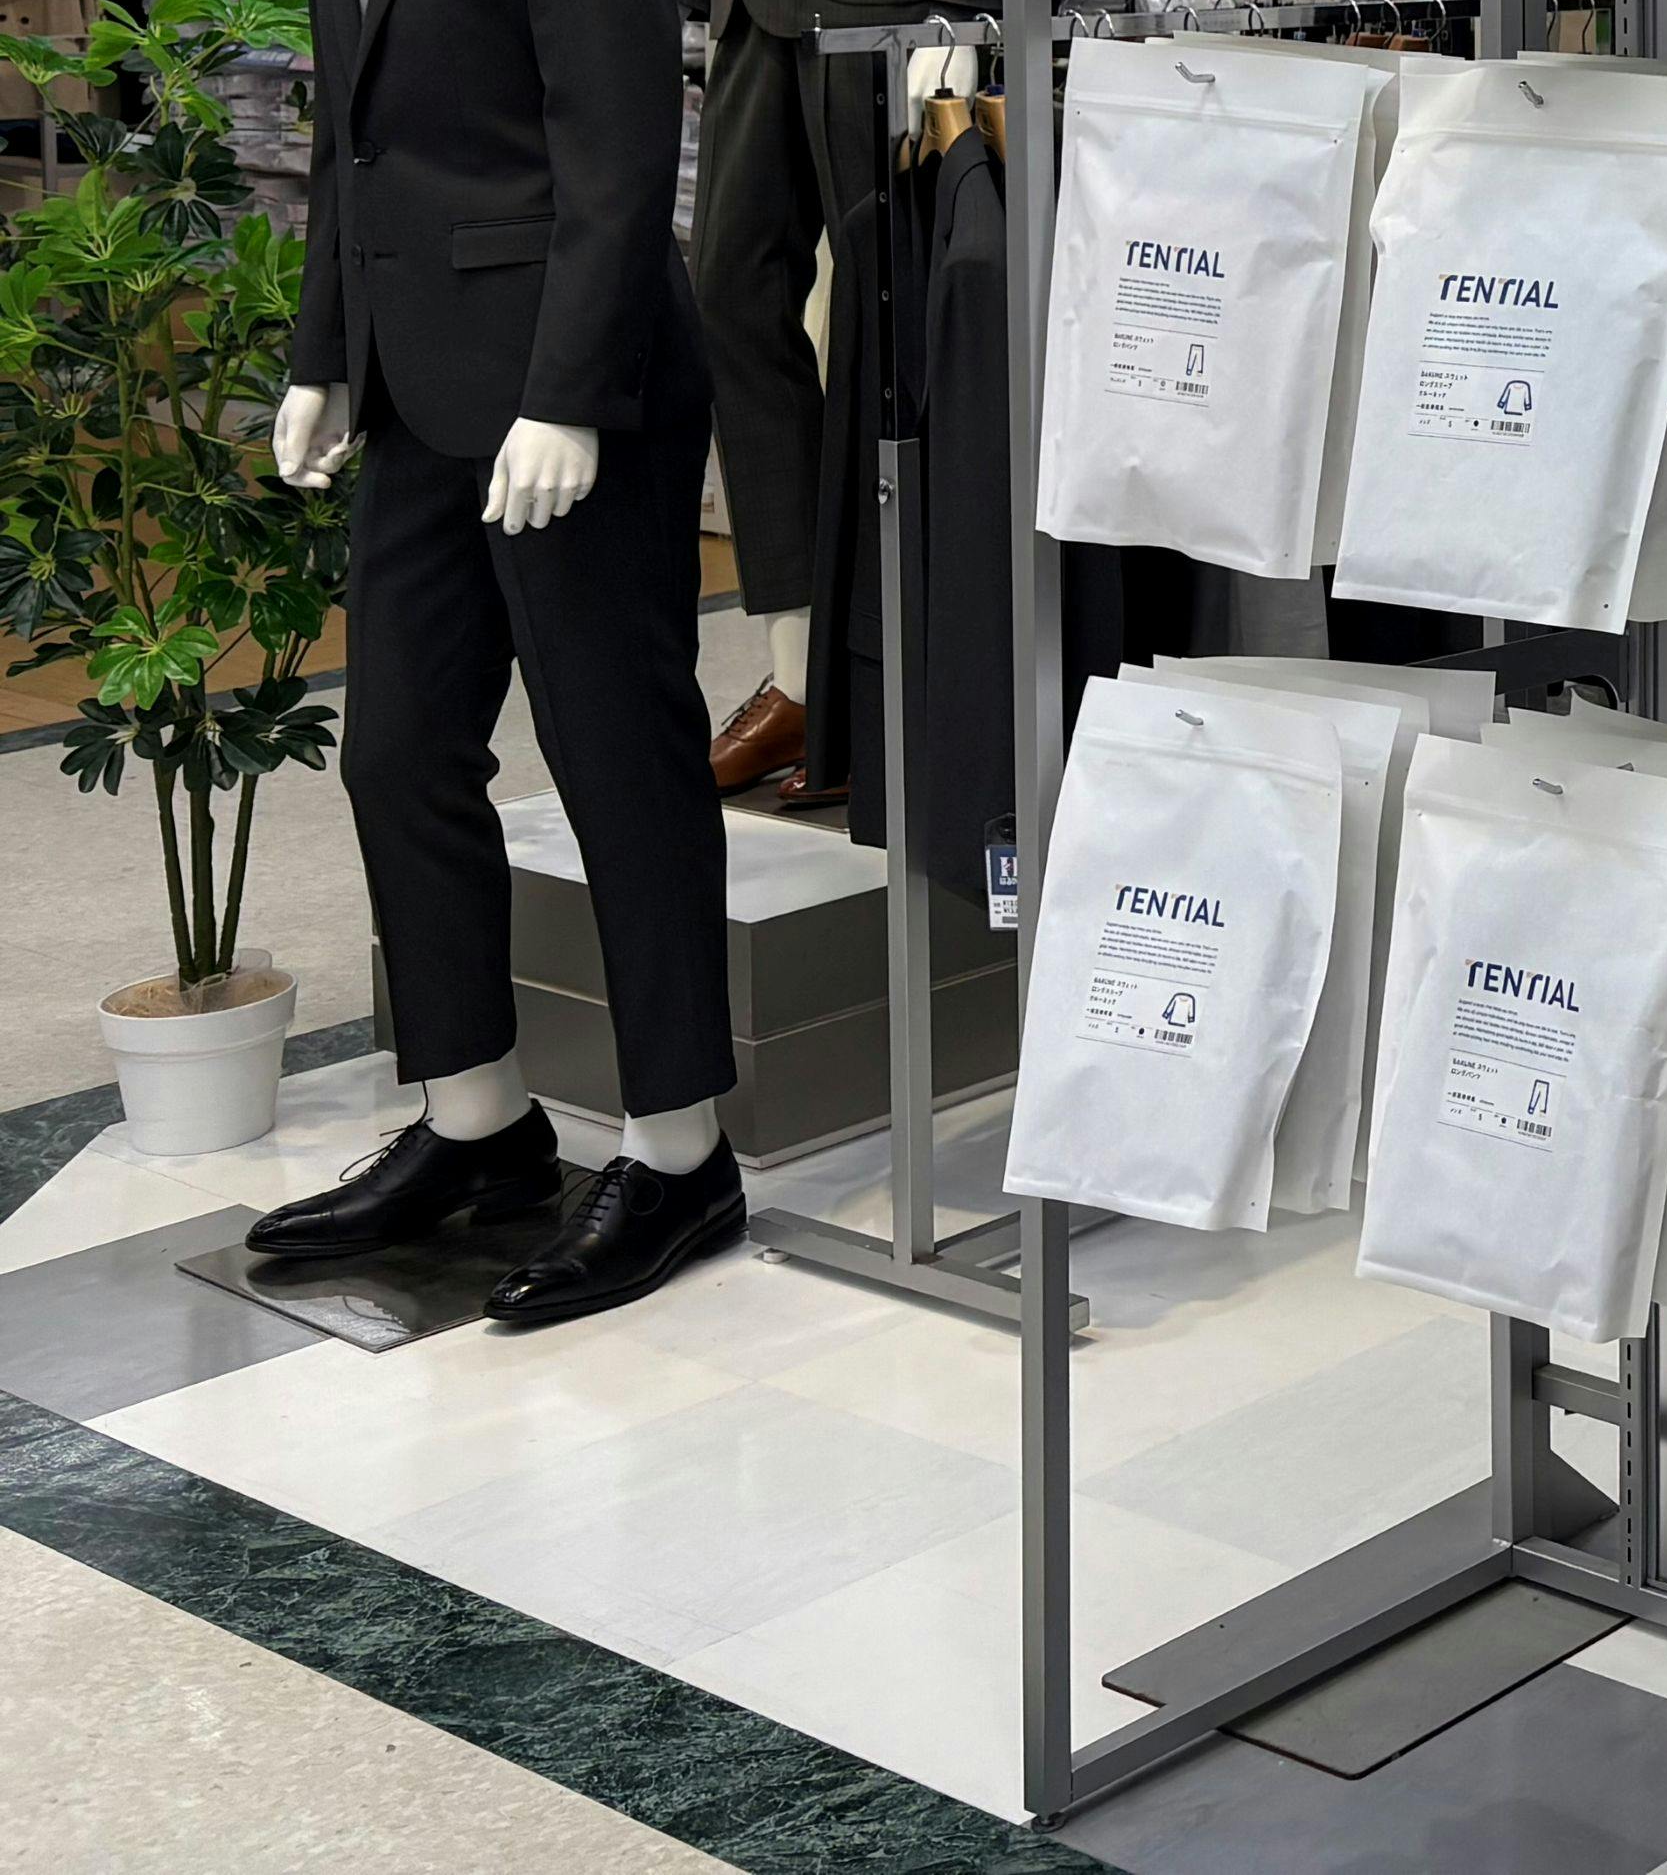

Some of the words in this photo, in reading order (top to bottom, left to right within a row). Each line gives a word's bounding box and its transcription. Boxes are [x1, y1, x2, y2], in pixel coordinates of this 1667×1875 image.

[1126, 241, 1225, 278] TENTIAL
[1439, 274, 1559, 309] TENTIAL
[1116, 883, 1225, 927] TENTIAL
[1465, 959, 1580, 1013] TENTIAL
